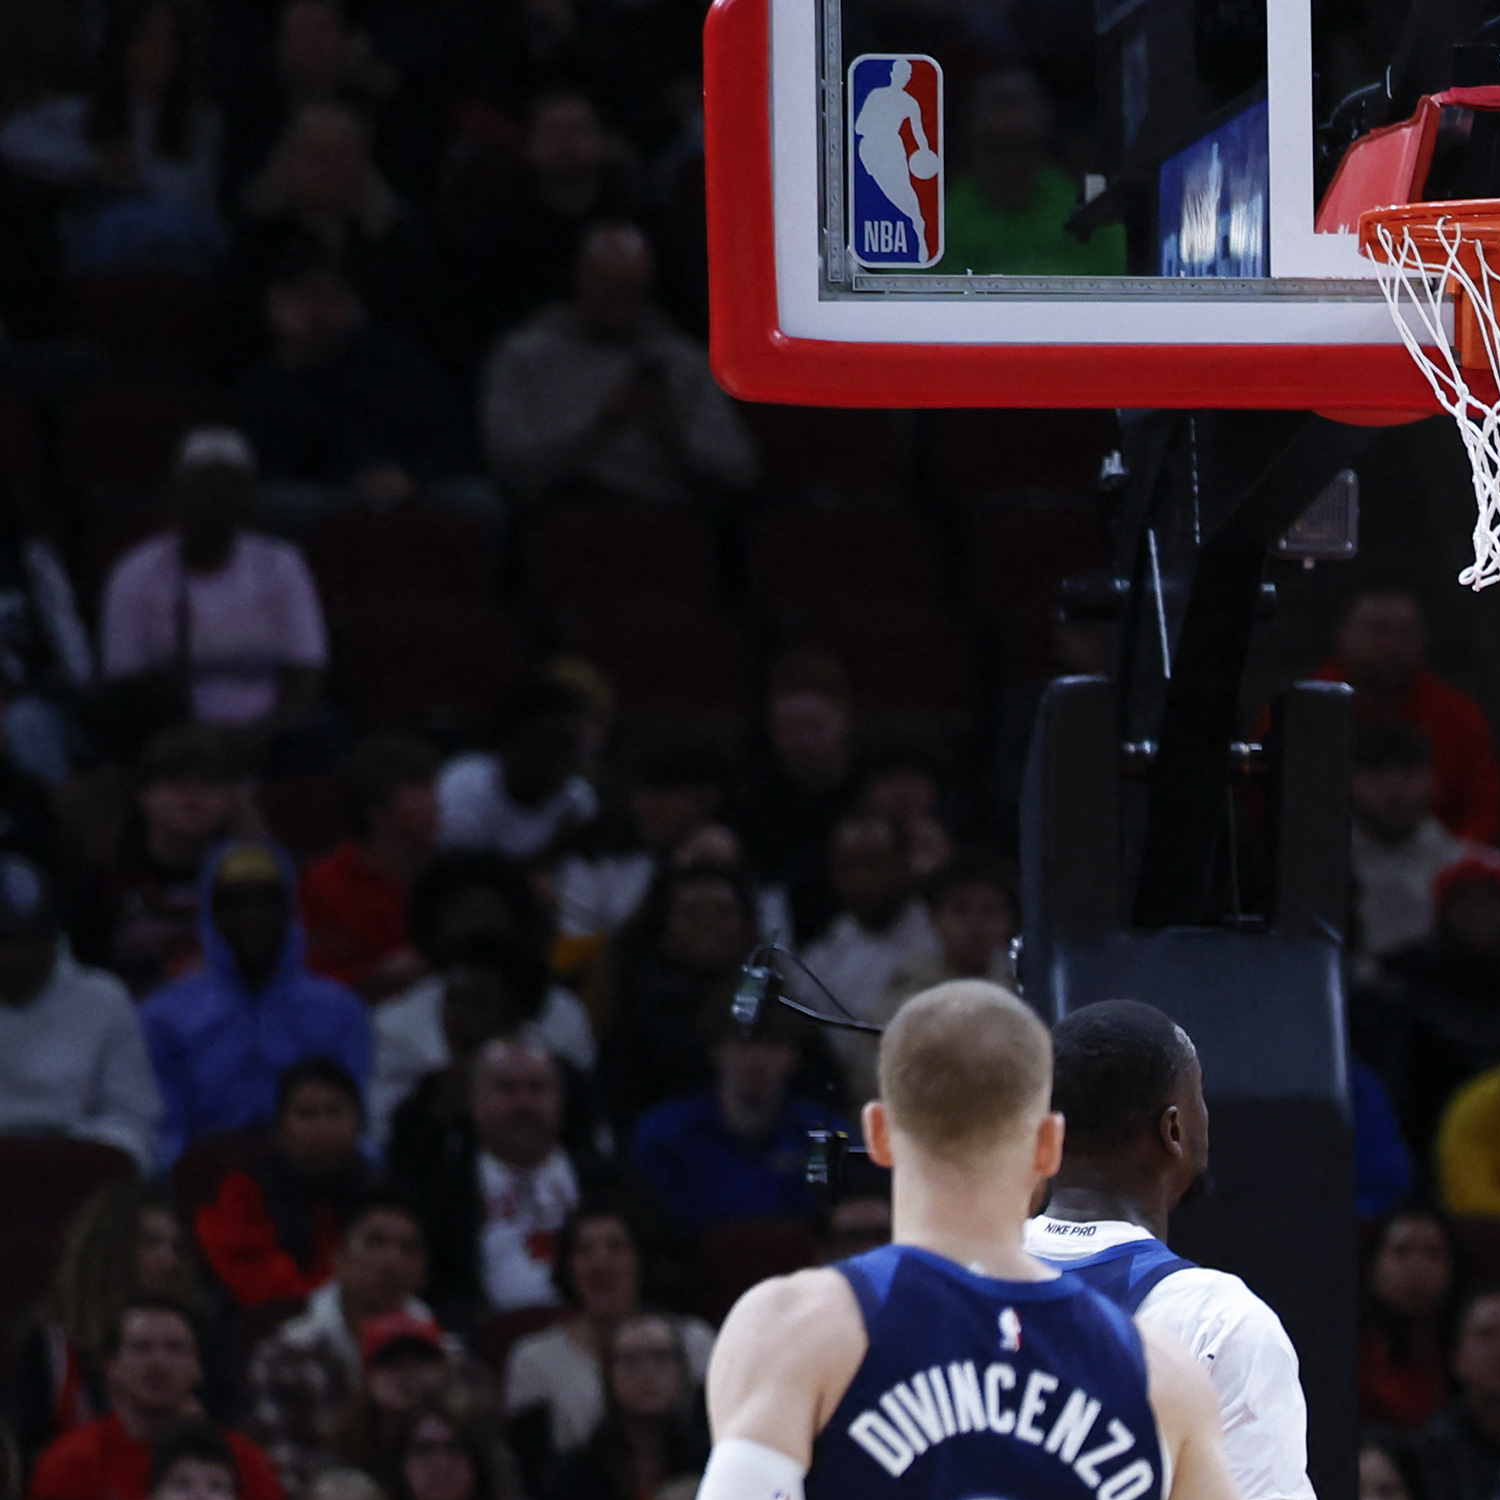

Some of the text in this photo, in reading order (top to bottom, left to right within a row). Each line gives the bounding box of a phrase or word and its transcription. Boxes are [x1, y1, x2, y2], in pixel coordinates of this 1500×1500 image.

[864, 220, 908, 253] NBA
[1044, 1222, 1097, 1237] NIKE PRO
